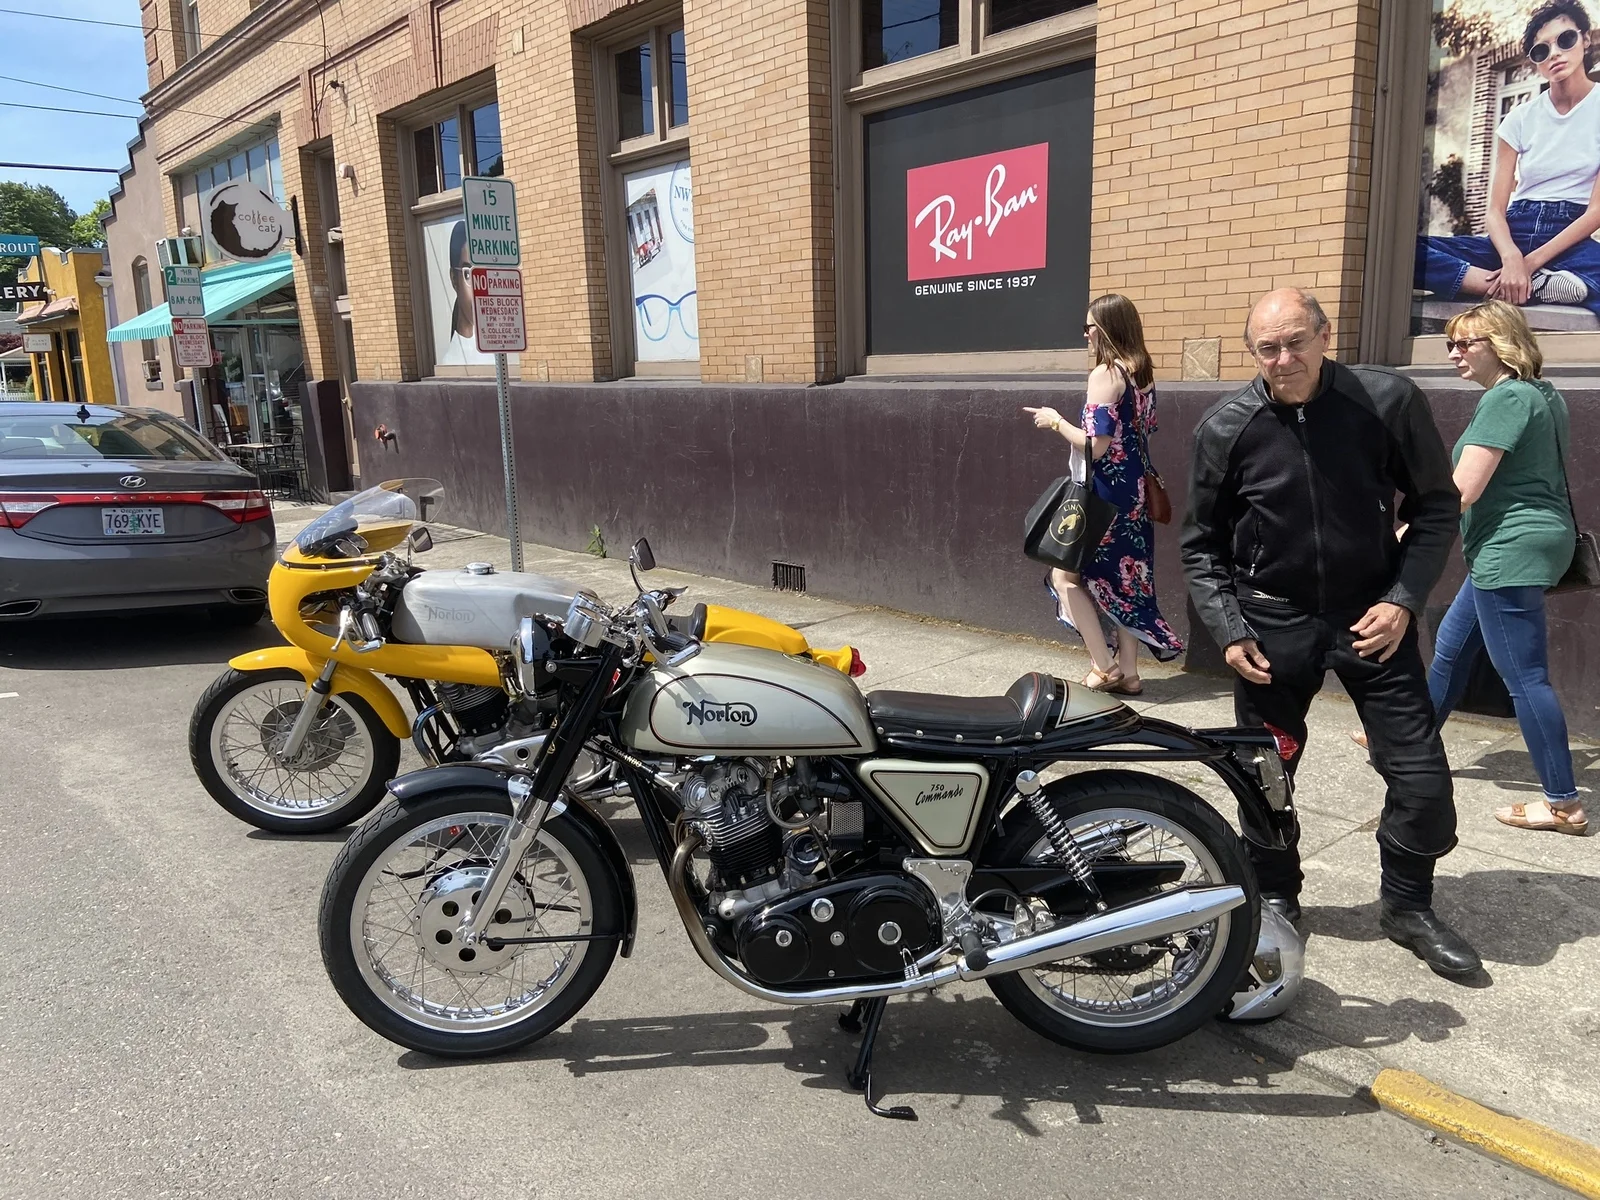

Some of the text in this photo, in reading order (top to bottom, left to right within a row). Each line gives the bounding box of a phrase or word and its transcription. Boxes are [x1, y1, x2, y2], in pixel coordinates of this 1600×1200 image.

[482, 190, 496, 206] 15
[238, 210, 275, 224] coffee
[472, 214, 512, 231] MINUTE
[258, 224, 276, 232] cat
[472, 238, 517, 256] PARKING
[166, 270, 174, 282] 2
[472, 274, 520, 290] NO PARKING
[915, 275, 1037, 296] GENUINE SINCE 1937
[170, 296, 202, 304] 8AM-6PM
[478, 298, 520, 306] THIS BLOCK
[480, 307, 518, 316] WEDNESDAYS
[173, 322, 182, 331] NO
[105, 514, 162, 528] 769 KYE
[424, 604, 476, 624] Norton
[683, 700, 758, 726] Norton
[915, 784, 964, 806] Commando
[930, 784, 944, 792] 750
